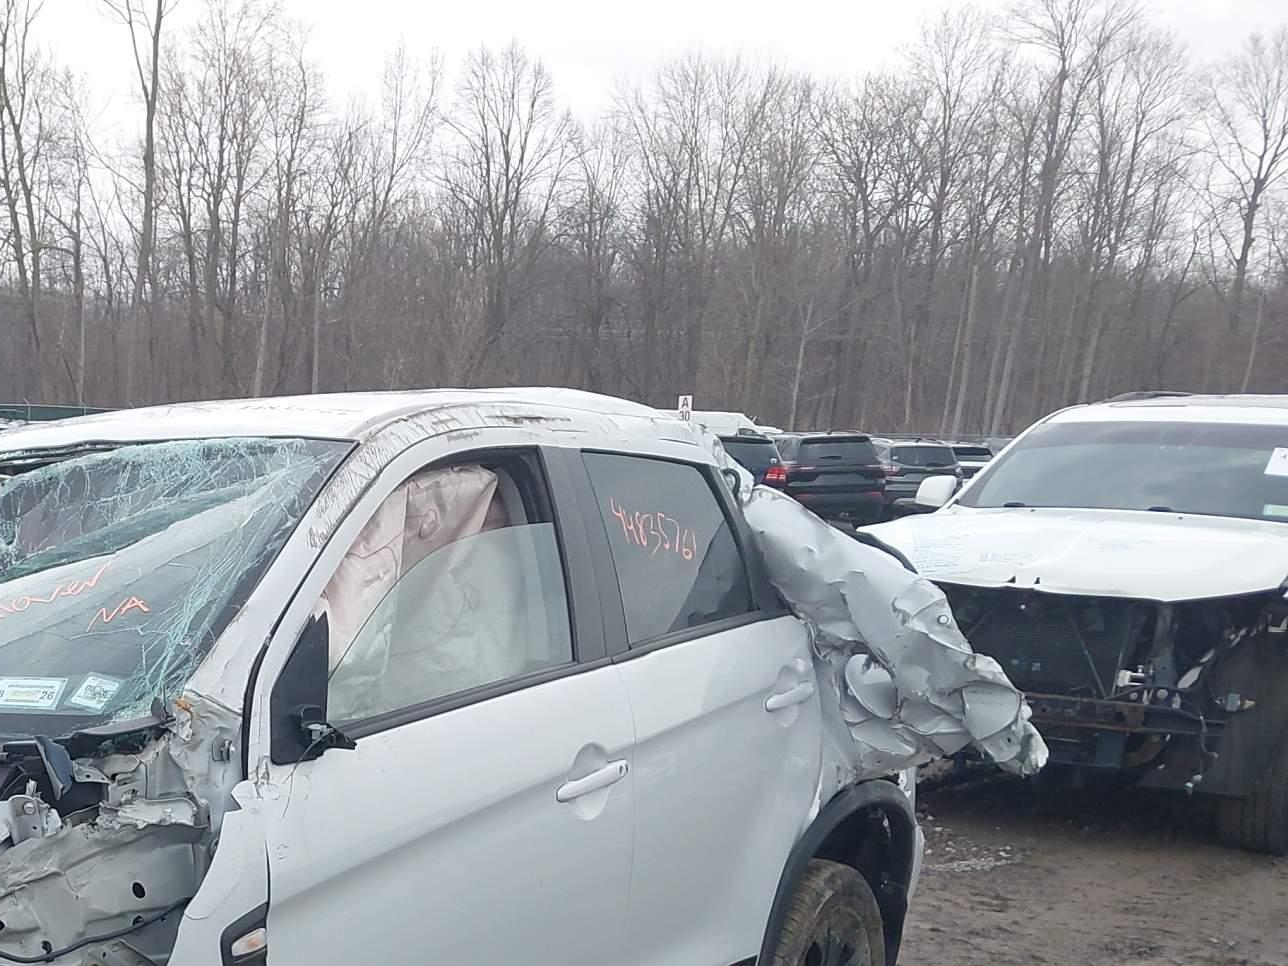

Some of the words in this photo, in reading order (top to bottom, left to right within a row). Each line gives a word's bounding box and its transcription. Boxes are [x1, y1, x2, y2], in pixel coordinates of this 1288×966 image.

[681, 397, 689, 408] A
[679, 410, 690, 421] 30
[609, 496, 697, 560] 44835761
[86, 595, 150, 633] NA
